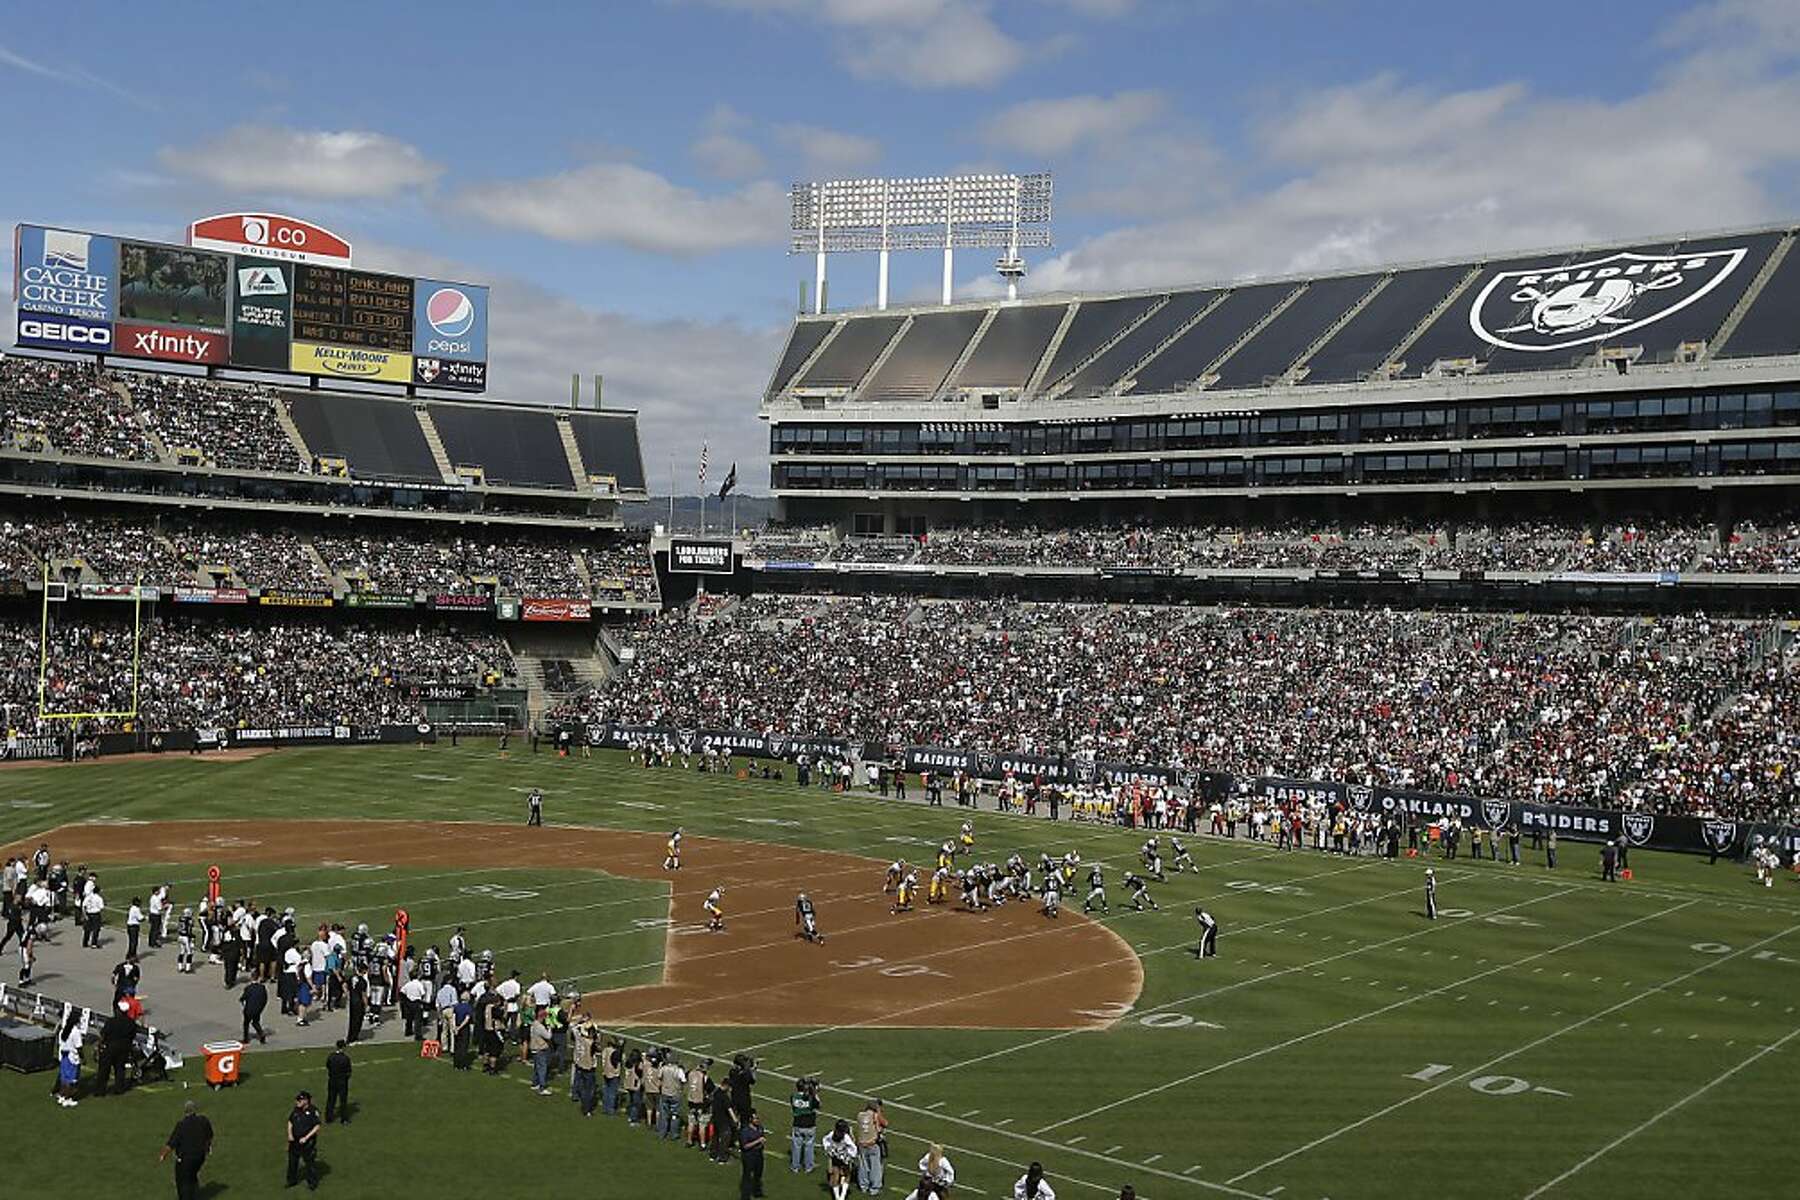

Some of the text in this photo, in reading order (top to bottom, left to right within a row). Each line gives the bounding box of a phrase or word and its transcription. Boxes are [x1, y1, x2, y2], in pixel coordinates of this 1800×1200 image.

[241, 246, 306, 261] COLISEUM
[23, 267, 107, 293] CACHE
[1517, 260, 1708, 287] RAIDERS
[350, 278, 411, 294] OAKLAND
[24, 286, 107, 310] CREEK
[350, 294, 411, 310] RAIDERS
[20, 321, 110, 346] GEICO
[135, 331, 208, 360] xfinity
[428, 339, 471, 354] pepsi
[315, 347, 390, 363] KELLY-MOORE
[449, 362, 484, 378] xfinity
[435, 596, 487, 605] SHARP
[913, 753, 968, 767] RAIDERS
[1522, 812, 1609, 833] RAIDERS
[218, 1056, 234, 1073] G
